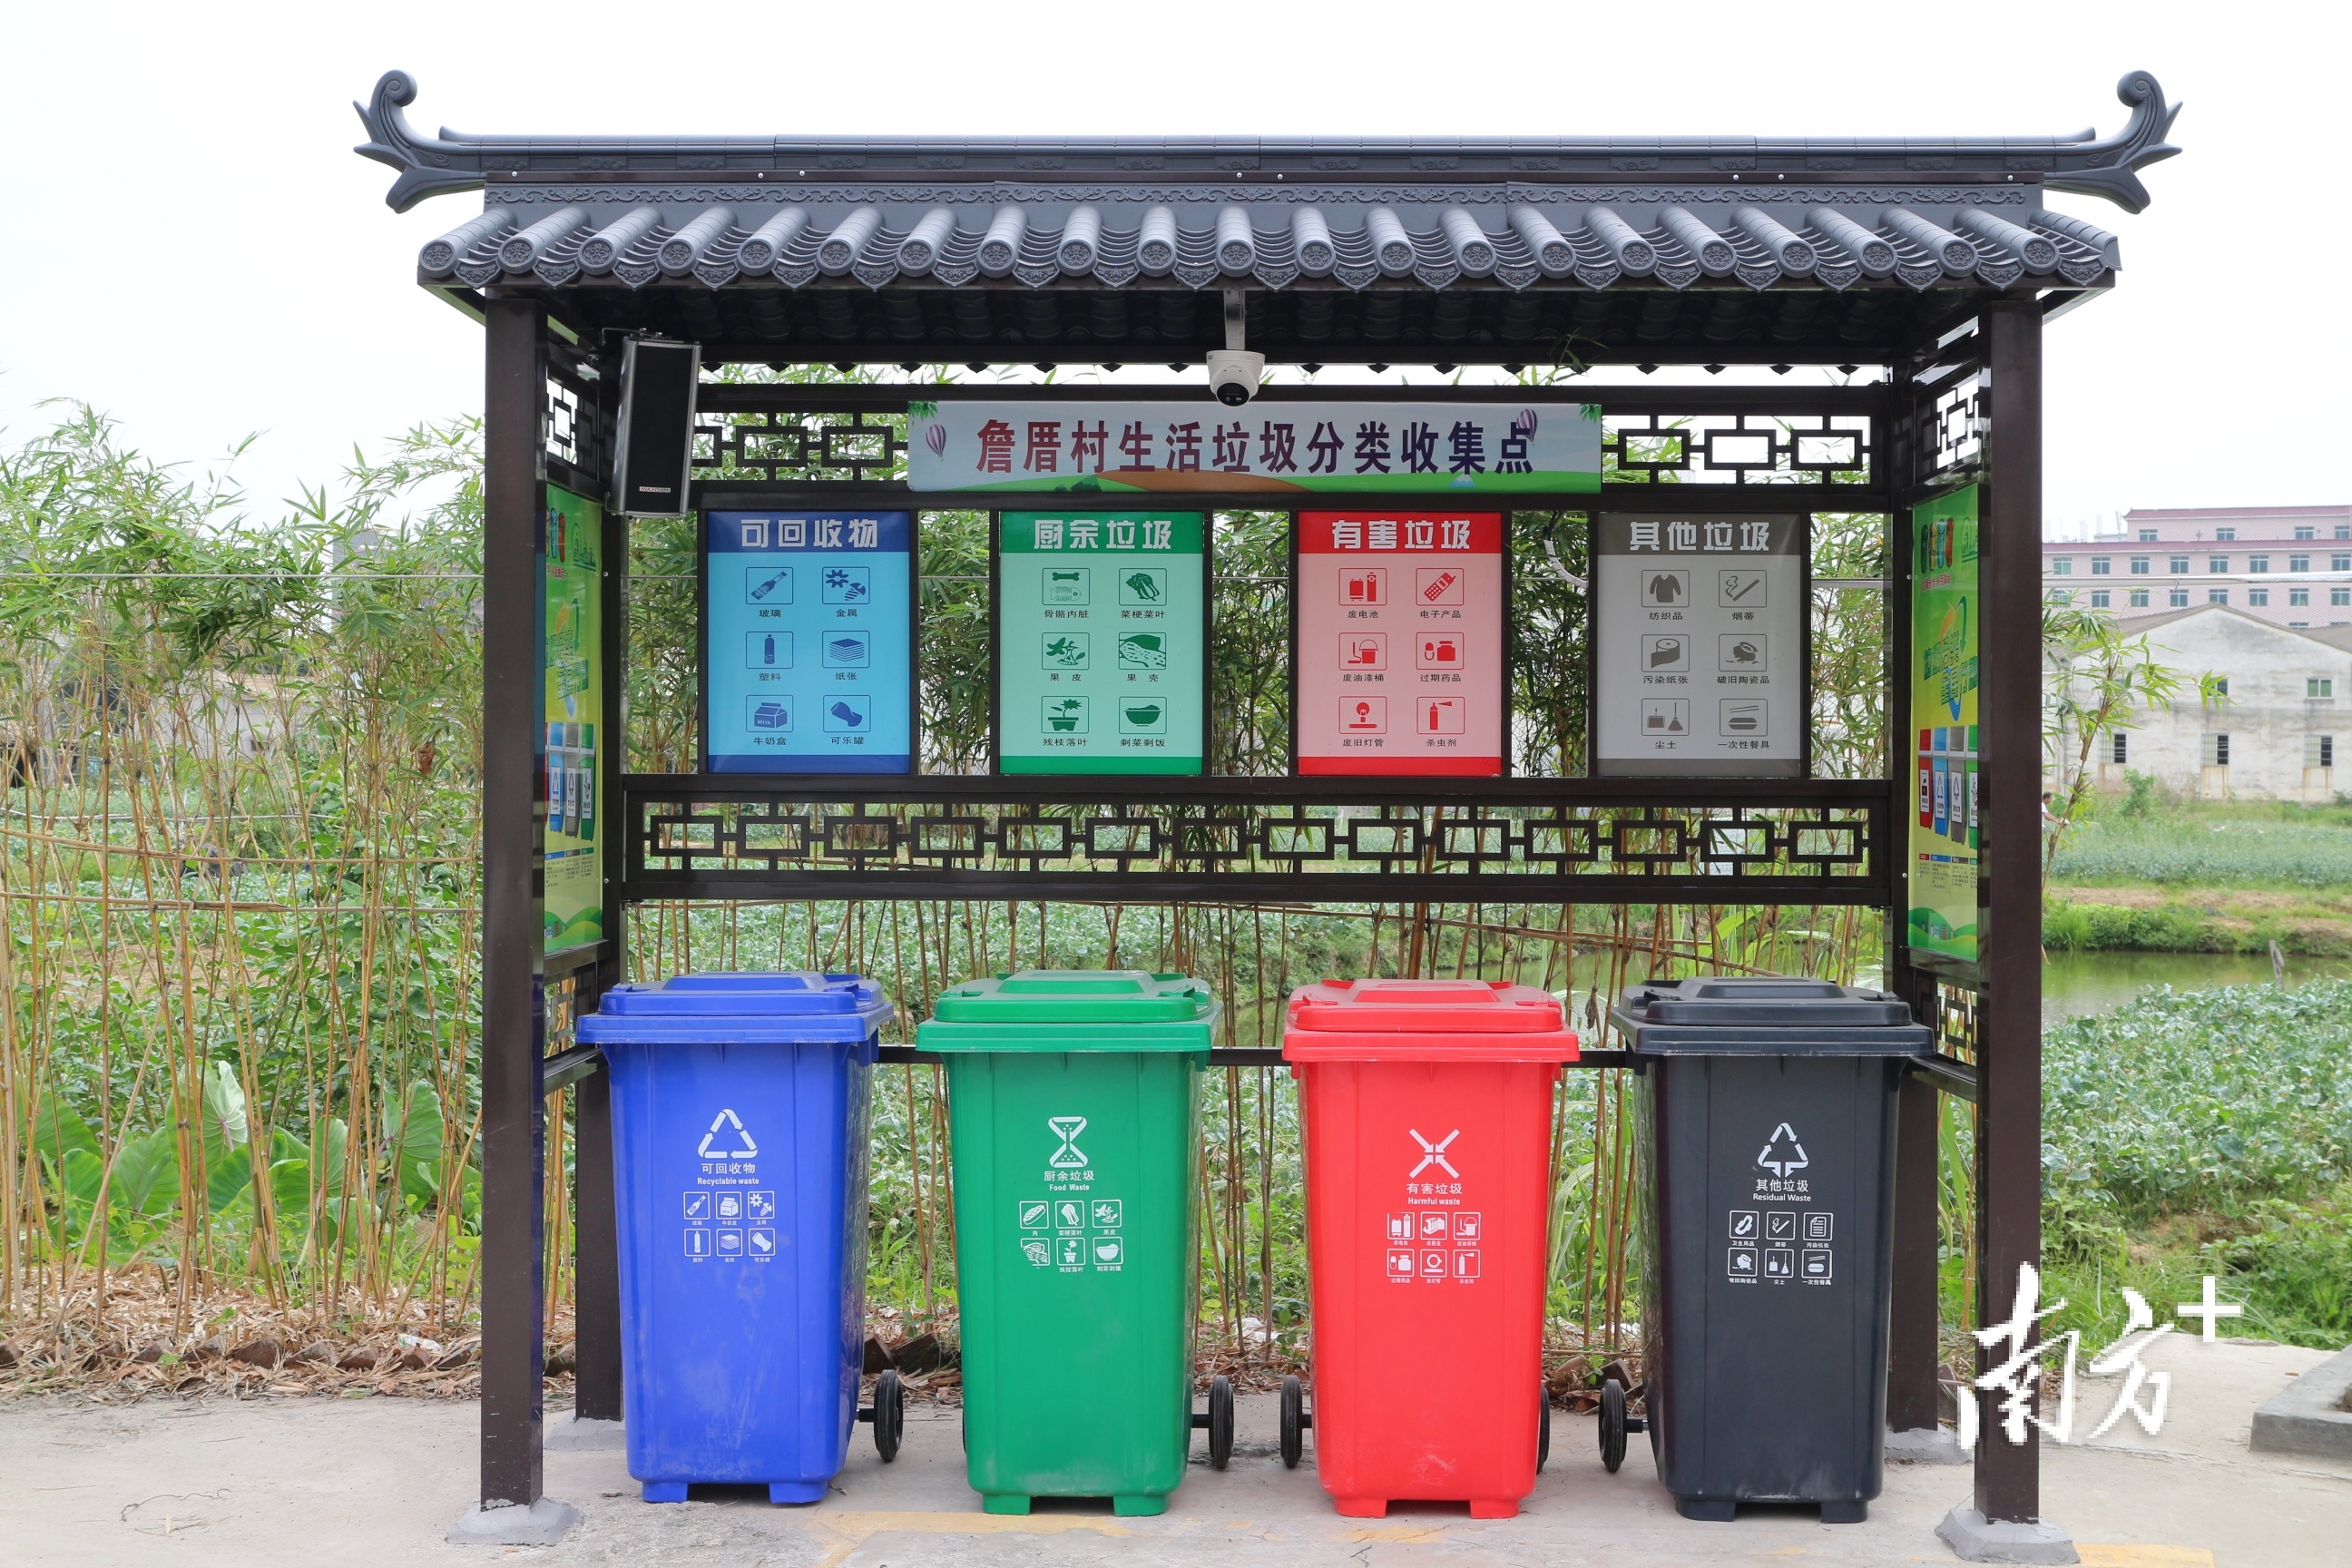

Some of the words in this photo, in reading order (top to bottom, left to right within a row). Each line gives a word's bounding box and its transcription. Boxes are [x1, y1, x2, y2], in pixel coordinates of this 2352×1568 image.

[975, 417, 1534, 476] 詹厝村生活垃圾分类收集点
[740, 518, 877, 548] 可回收物
[1034, 519, 1172, 550] 厨余垃圾
[1332, 519, 1470, 549] 有害垃圾
[1630, 521, 1769, 552] 其他垃圾
[759, 609, 781, 618] 玻璃
[836, 608, 858, 618] 金属
[1044, 610, 1089, 619] 骨骼内脏
[1120, 610, 1166, 619] 菜梗菜叶
[1348, 610, 1379, 619] 废电池
[1420, 610, 1461, 619] 电子产品
[1649, 612, 1683, 621] 纺织品
[1731, 612, 1754, 621] 烟蒂
[759, 672, 781, 681] 塑料
[835, 671, 858, 681] 纸张
[1343, 674, 1384, 682] 废油漆桶
[1420, 674, 1461, 682] 过期药品
[1642, 675, 1689, 684] 污染纸张
[1717, 675, 1769, 684] 破旧陶瓷品
[753, 736, 787, 746] 牛奶盒
[830, 736, 864, 745] 可乐罐
[1043, 738, 1088, 747] 残枝落叶
[1120, 738, 1166, 748] 剩菜剩饭
[1343, 739, 1384, 748] 废旧灯管
[1426, 739, 1456, 748] 杀虫剂
[1655, 740, 1676, 750] 尘土
[1718, 740, 1770, 750] 一次性餐具
[701, 1162, 756, 1175] 可回收物
[1044, 1171, 1095, 1181] 厨余垃圾
[697, 1177, 737, 1186] Recyclable
[1756, 1179, 1808, 1192] 其他垃圾
[1406, 1183, 1463, 1195] 有害垃圾
[1408, 1197, 1437, 1205] Harmful
[1752, 1193, 1786, 1201] Residual
[1788, 1194, 1811, 1202] Waste
